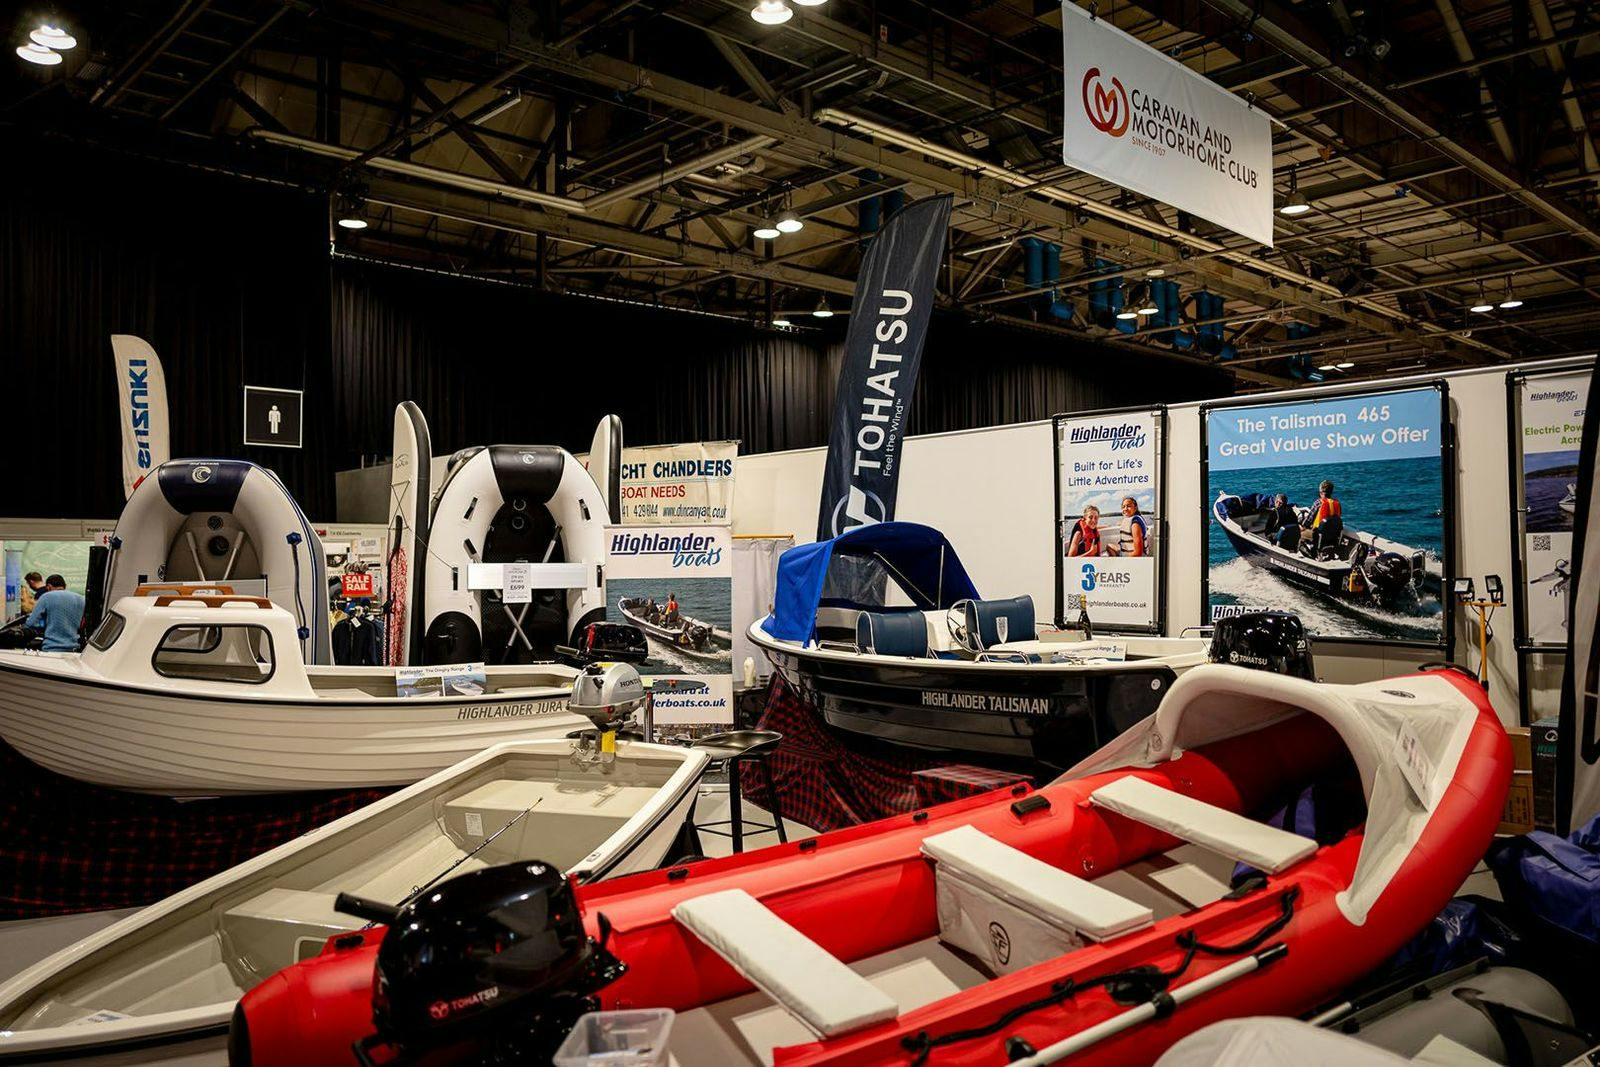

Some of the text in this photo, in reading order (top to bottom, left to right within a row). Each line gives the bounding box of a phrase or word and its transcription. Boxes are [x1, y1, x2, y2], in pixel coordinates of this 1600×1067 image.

[1131, 89, 1232, 155] CARAVAN AND
[1131, 136, 1152, 150] SINCE
[1132, 114, 1258, 189] MOTORHOME CLUB
[853, 289, 914, 476] TOHATSU
[1530, 391, 1575, 401] Highlander
[1237, 405, 1390, 433] The Talisman 465
[1070, 423, 1141, 444] Highlander
[1525, 424, 1561, 436] Electric
[886, 434, 896, 452] the
[1111, 431, 1146, 451] boats
[1220, 427, 1429, 457] Great Value Show Offer
[653, 459, 732, 479] CHANDLERS
[883, 455, 894, 477] Feel
[1074, 459, 1143, 472] Built for Life's
[1068, 475, 1149, 486] Little Adventures
[651, 485, 686, 498] NEEDS
[611, 533, 715, 555] Highlander
[673, 545, 722, 568] boats
[345, 575, 370, 584] SALE
[346, 583, 369, 591] RAIL
[1081, 563, 1131, 591] 3 YEARS
[1296, 639, 1306, 649] 20
[1239, 655, 1268, 666] TOHATSU
[457, 704, 533, 720] HIGHLANDER
[536, 700, 562, 714] JURA
[922, 691, 1049, 714] HIGHLANDER TALISMAN
[451, 986, 499, 1010] TOHATSU
